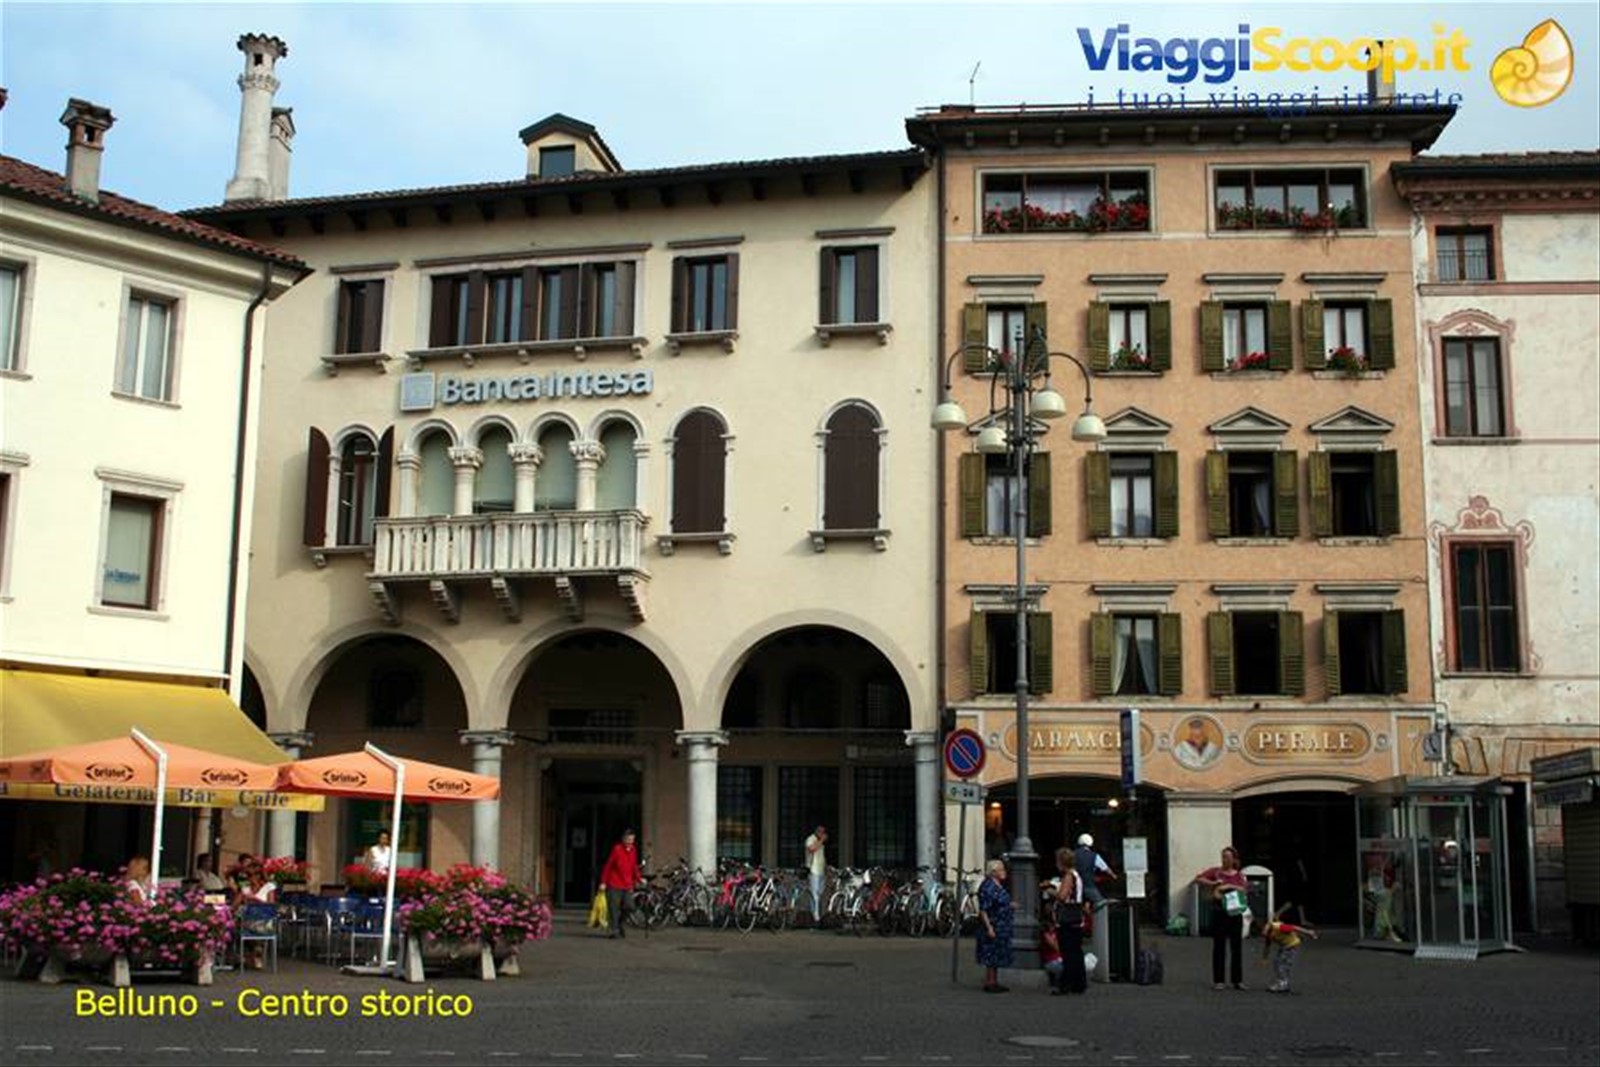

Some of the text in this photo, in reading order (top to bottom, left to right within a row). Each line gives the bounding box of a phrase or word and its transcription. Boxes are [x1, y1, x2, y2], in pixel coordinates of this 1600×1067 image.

[441, 367, 653, 404] Banca Intesa
[1027, 731, 1354, 750] ARMACI PERALE
[179, 787, 216, 804] Bar
